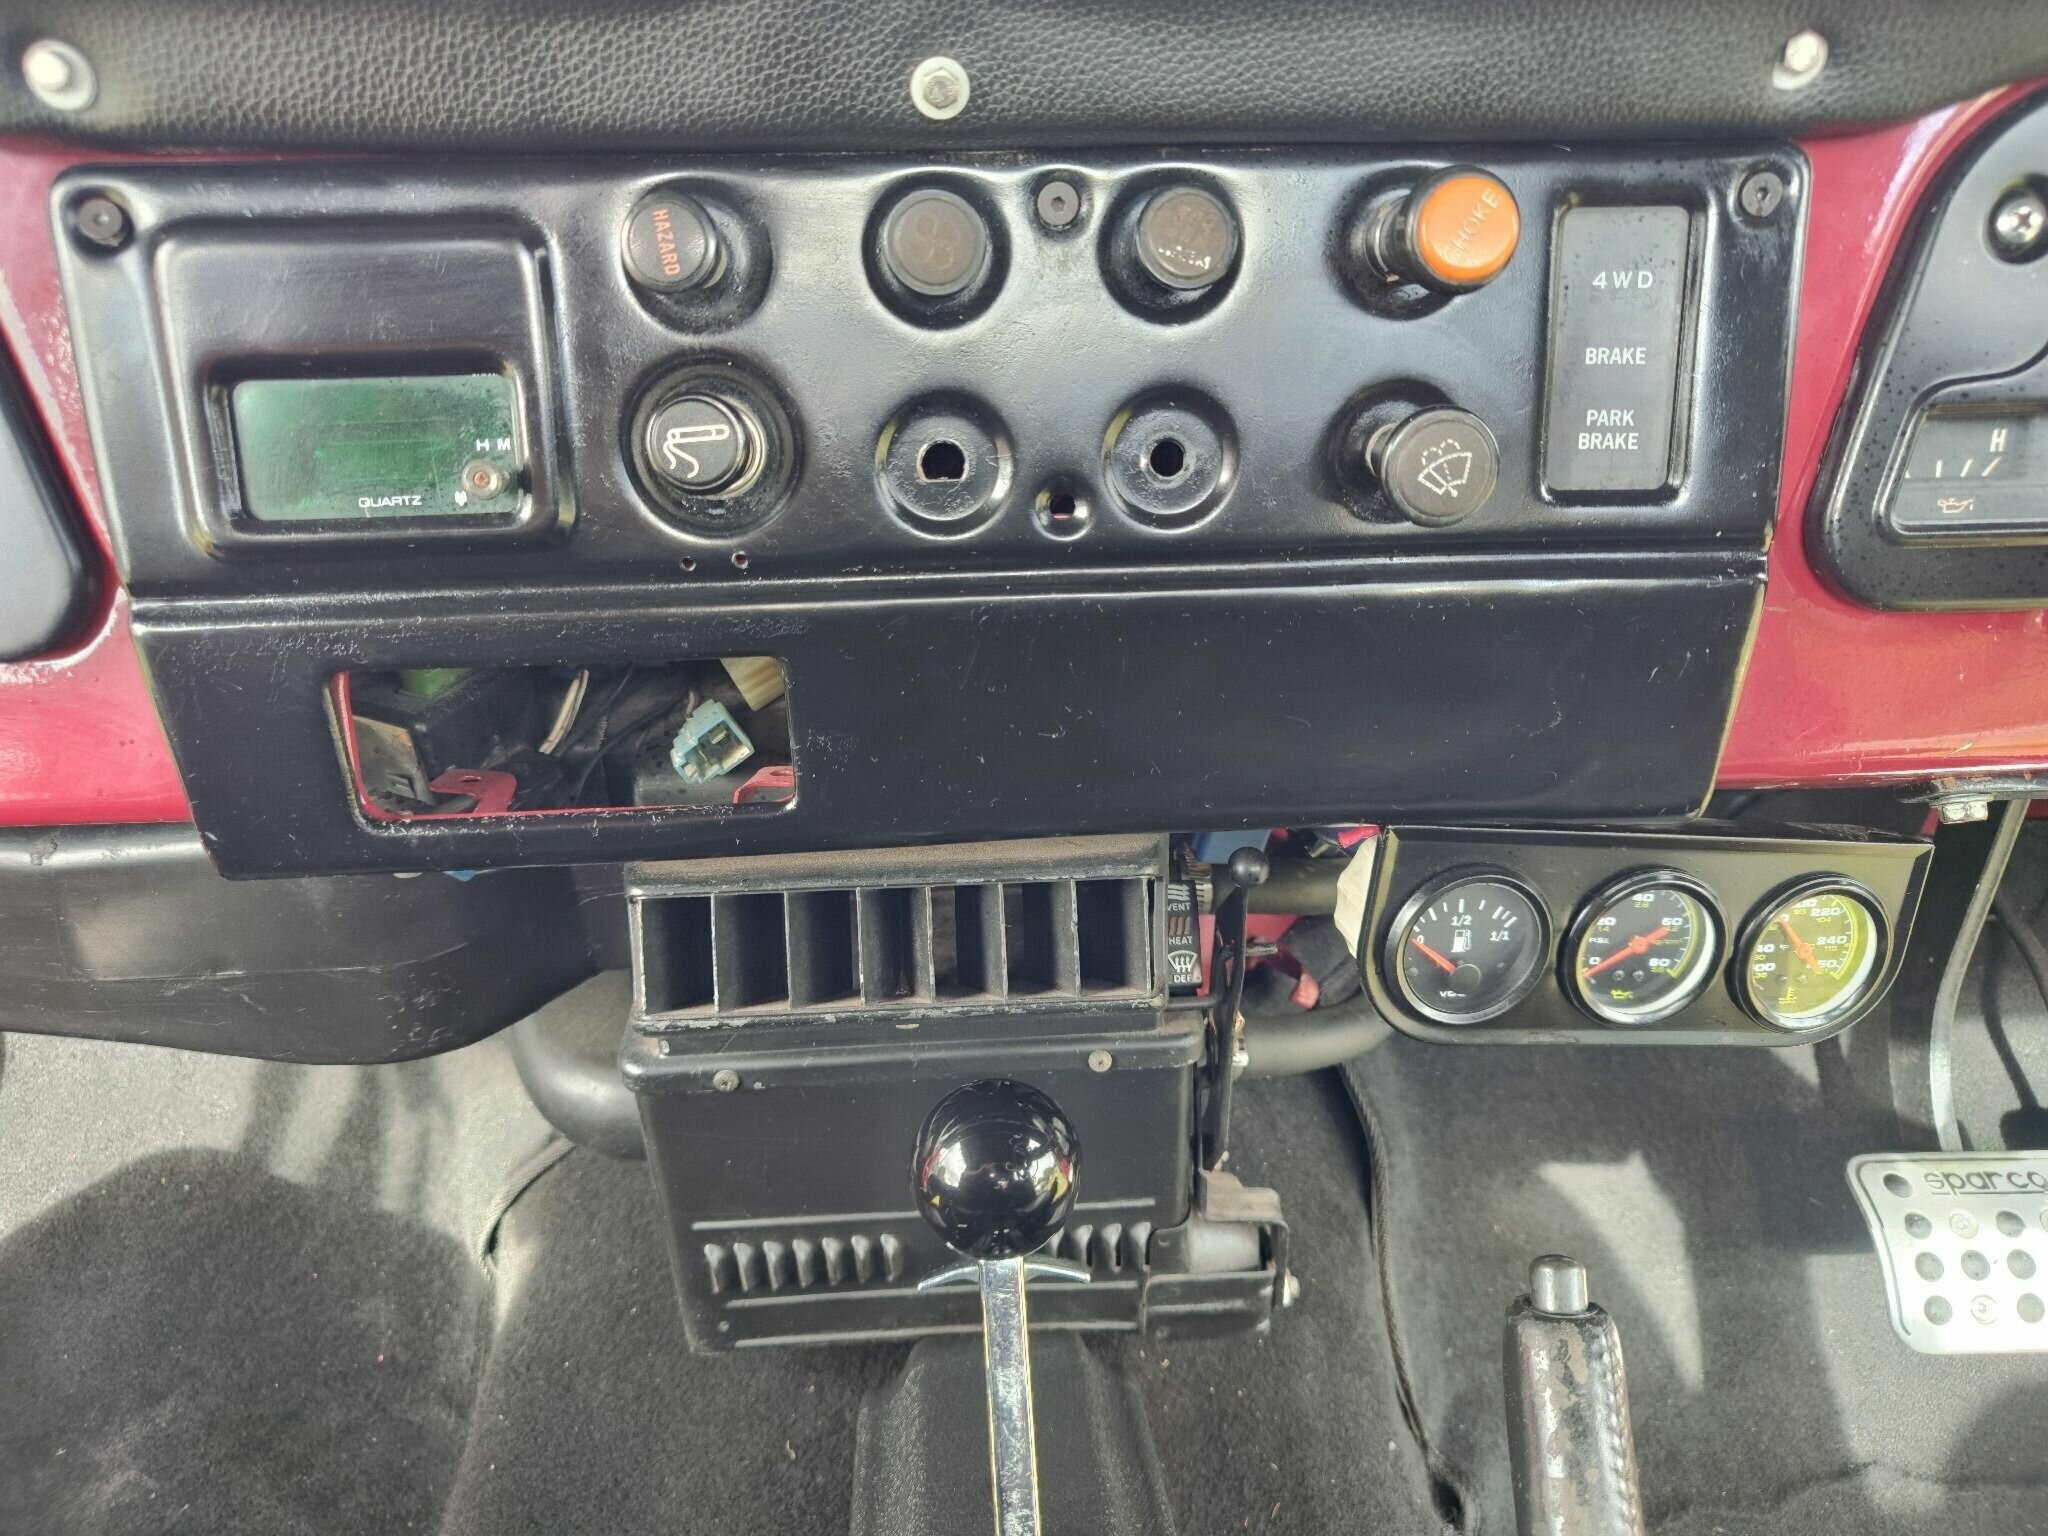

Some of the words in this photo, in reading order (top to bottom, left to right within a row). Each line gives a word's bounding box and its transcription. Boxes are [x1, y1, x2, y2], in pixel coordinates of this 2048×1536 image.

[652, 208, 681, 275] HAZARD
[1585, 347, 1647, 365] BRAKE
[1586, 409, 1634, 427] PARK
[476, 438, 489, 451] H
[497, 438, 511, 451] M
[1578, 432, 1639, 450] BRAKE
[1990, 428, 2008, 452] H
[358, 495, 422, 508] QUARTZ
[1632, 893, 1655, 902] 40
[1167, 902, 1191, 911] VENT
[1810, 908, 1841, 917] 220
[1451, 915, 1472, 926] 1/2
[1168, 936, 1193, 945] HEAT
[1490, 930, 1510, 942] 1/1
[1817, 936, 1848, 945] 240
[1924, 1171, 2048, 1195] sparco
